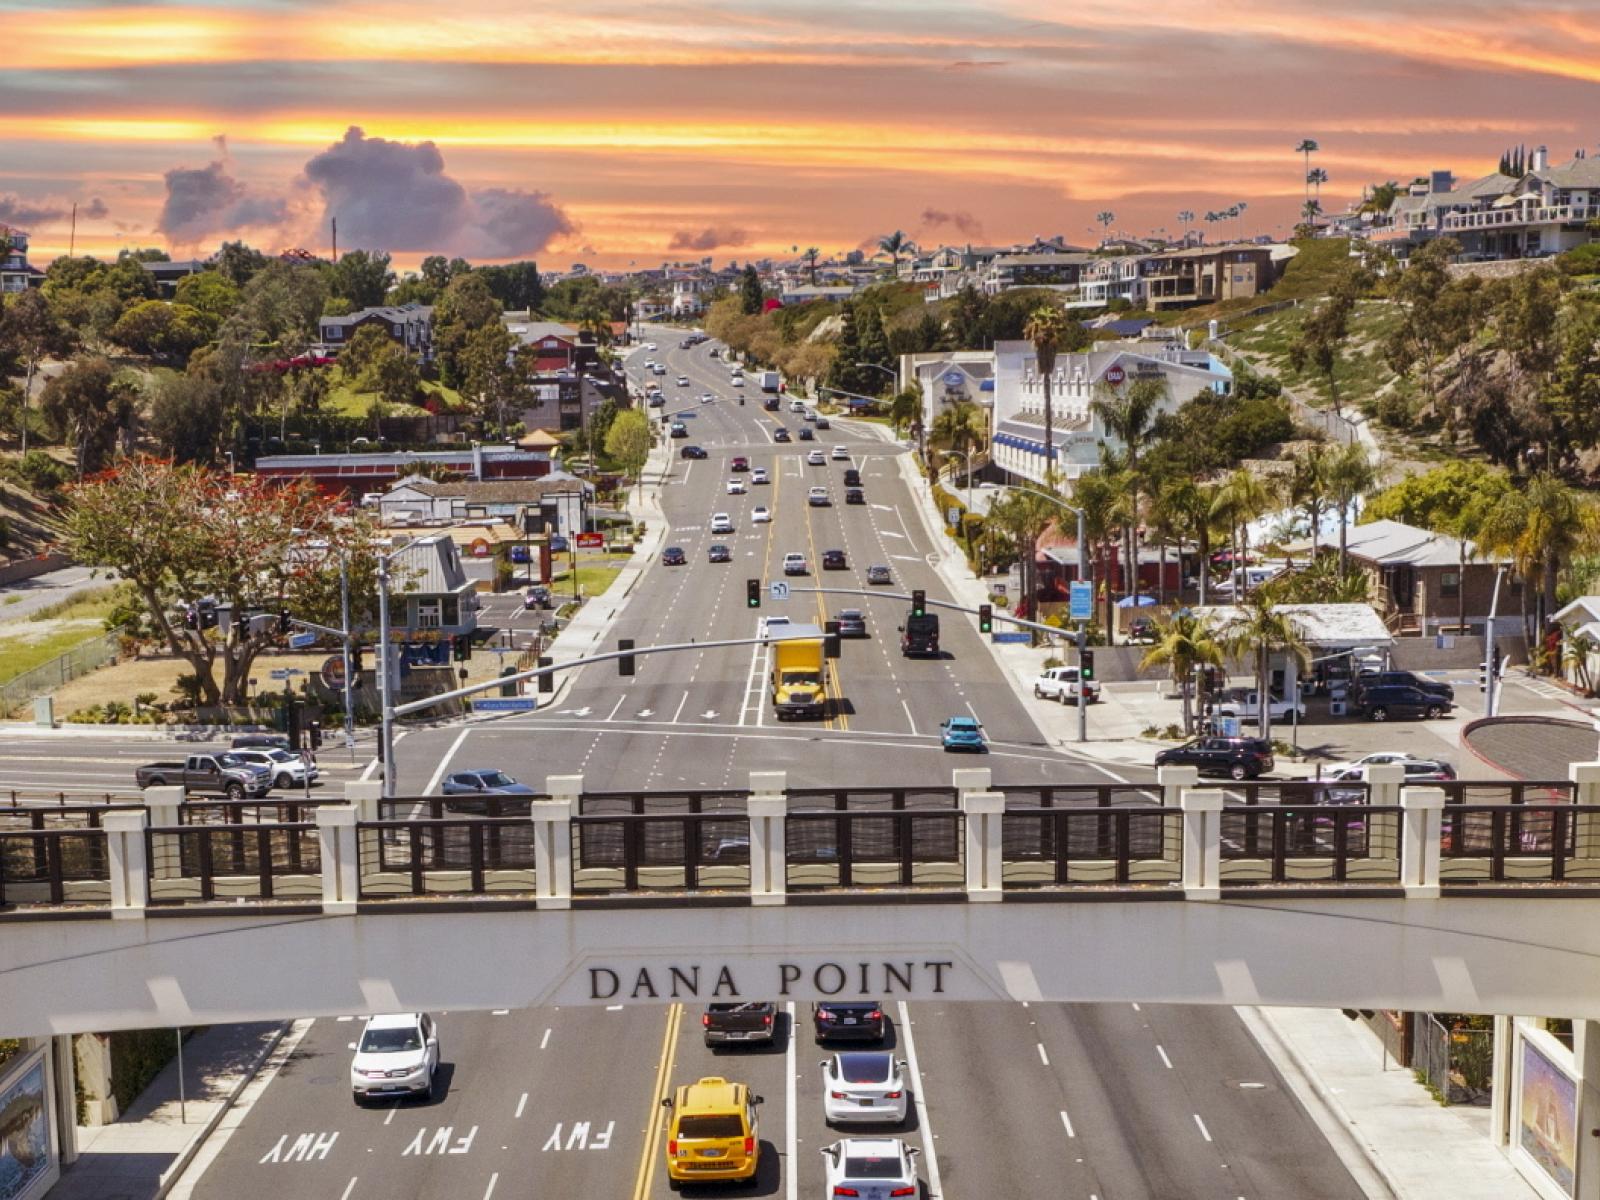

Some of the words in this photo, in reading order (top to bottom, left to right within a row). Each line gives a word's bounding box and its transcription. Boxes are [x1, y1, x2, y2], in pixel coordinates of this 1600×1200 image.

[588, 965, 741, 999] DANA
[778, 960, 954, 995] POINT
[259, 1131, 340, 1164] HWY
[401, 1125, 479, 1156] FWY
[541, 1120, 616, 1152] FWY
